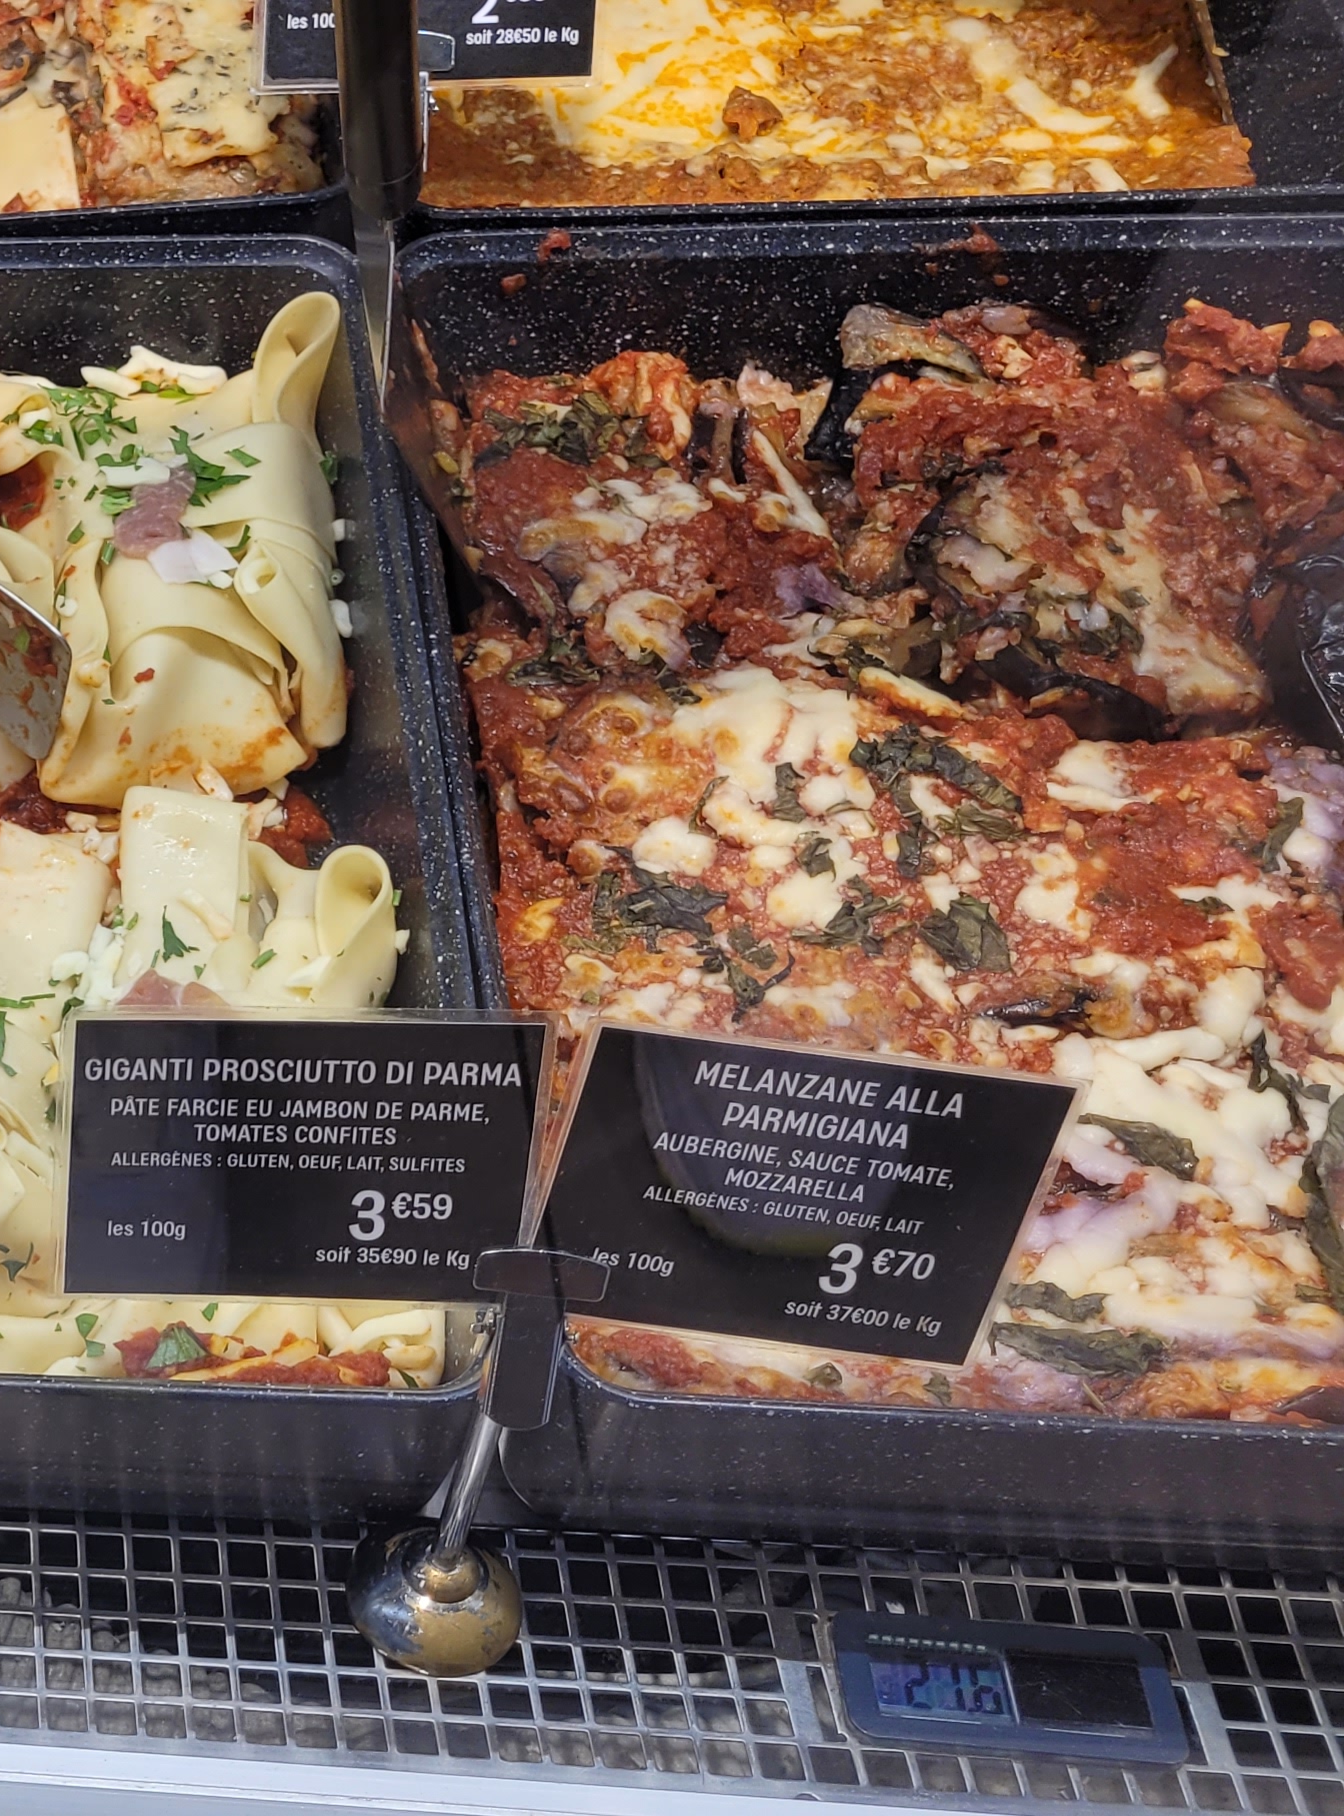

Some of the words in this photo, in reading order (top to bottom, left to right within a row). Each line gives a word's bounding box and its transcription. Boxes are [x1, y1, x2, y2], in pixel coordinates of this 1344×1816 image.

[286, 13, 309, 30] les
[312, 12, 336, 30] 100
[466, 28, 494, 46] soit
[496, 28, 541, 45] 28€50
[543, 28, 558, 44] le
[561, 26, 579, 46] Kg
[84, 1057, 193, 1083] GIGANTI
[203, 1058, 377, 1086] PROSCIUTTO
[385, 1061, 414, 1085] DI
[423, 1062, 522, 1088] PARMA
[693, 1060, 881, 1107] MELANZANE
[885, 1086, 964, 1119] ALLA
[110, 1095, 160, 1117] PÂTE
[167, 1097, 238, 1118] FARCIE
[245, 1098, 273, 1119] EU
[279, 1099, 369, 1120] JAMBON
[375, 1101, 402, 1121] DE
[410, 1101, 490, 1126] PARME,
[194, 1124, 288, 1144] TOMATES
[294, 1125, 397, 1146] CONFITES
[721, 1102, 909, 1151] PARMIGIANA
[111, 1150, 213, 1169] ALLERGÈNES
[226, 1153, 293, 1172] GLUTEN,
[298, 1155, 342, 1173] OEUF,
[347, 1155, 385, 1174] LAIT,
[389, 1156, 466, 1174] SULFITES
[653, 1132, 783, 1169] AUBERGINE,
[788, 1148, 859, 1177] SAUCE
[867, 1159, 955, 1191] TOMATE,
[724, 1168, 864, 1204] MOZZARELLA
[348, 1189, 386, 1242] 3
[391, 1193, 454, 1221] €59
[643, 1184, 750, 1214] ALLERGÈNES
[762, 1200, 831, 1227] GLUTEN,
[835, 1210, 881, 1233] OEUF,
[884, 1216, 924, 1236] LAIT
[107, 1220, 135, 1238] les
[140, 1220, 187, 1242] 100g
[315, 1246, 351, 1265] soit
[356, 1248, 417, 1267] 35€90
[422, 1250, 440, 1268] le
[446, 1251, 470, 1272] Kg
[592, 1246, 620, 1266] les
[627, 1252, 674, 1277] 100g
[818, 1242, 864, 1296] 3
[871, 1249, 936, 1283] €70
[784, 1298, 822, 1322] soit
[825, 1303, 889, 1329] 37€00
[892, 1309, 910, 1330] le
[914, 1314, 942, 1338] Kg
